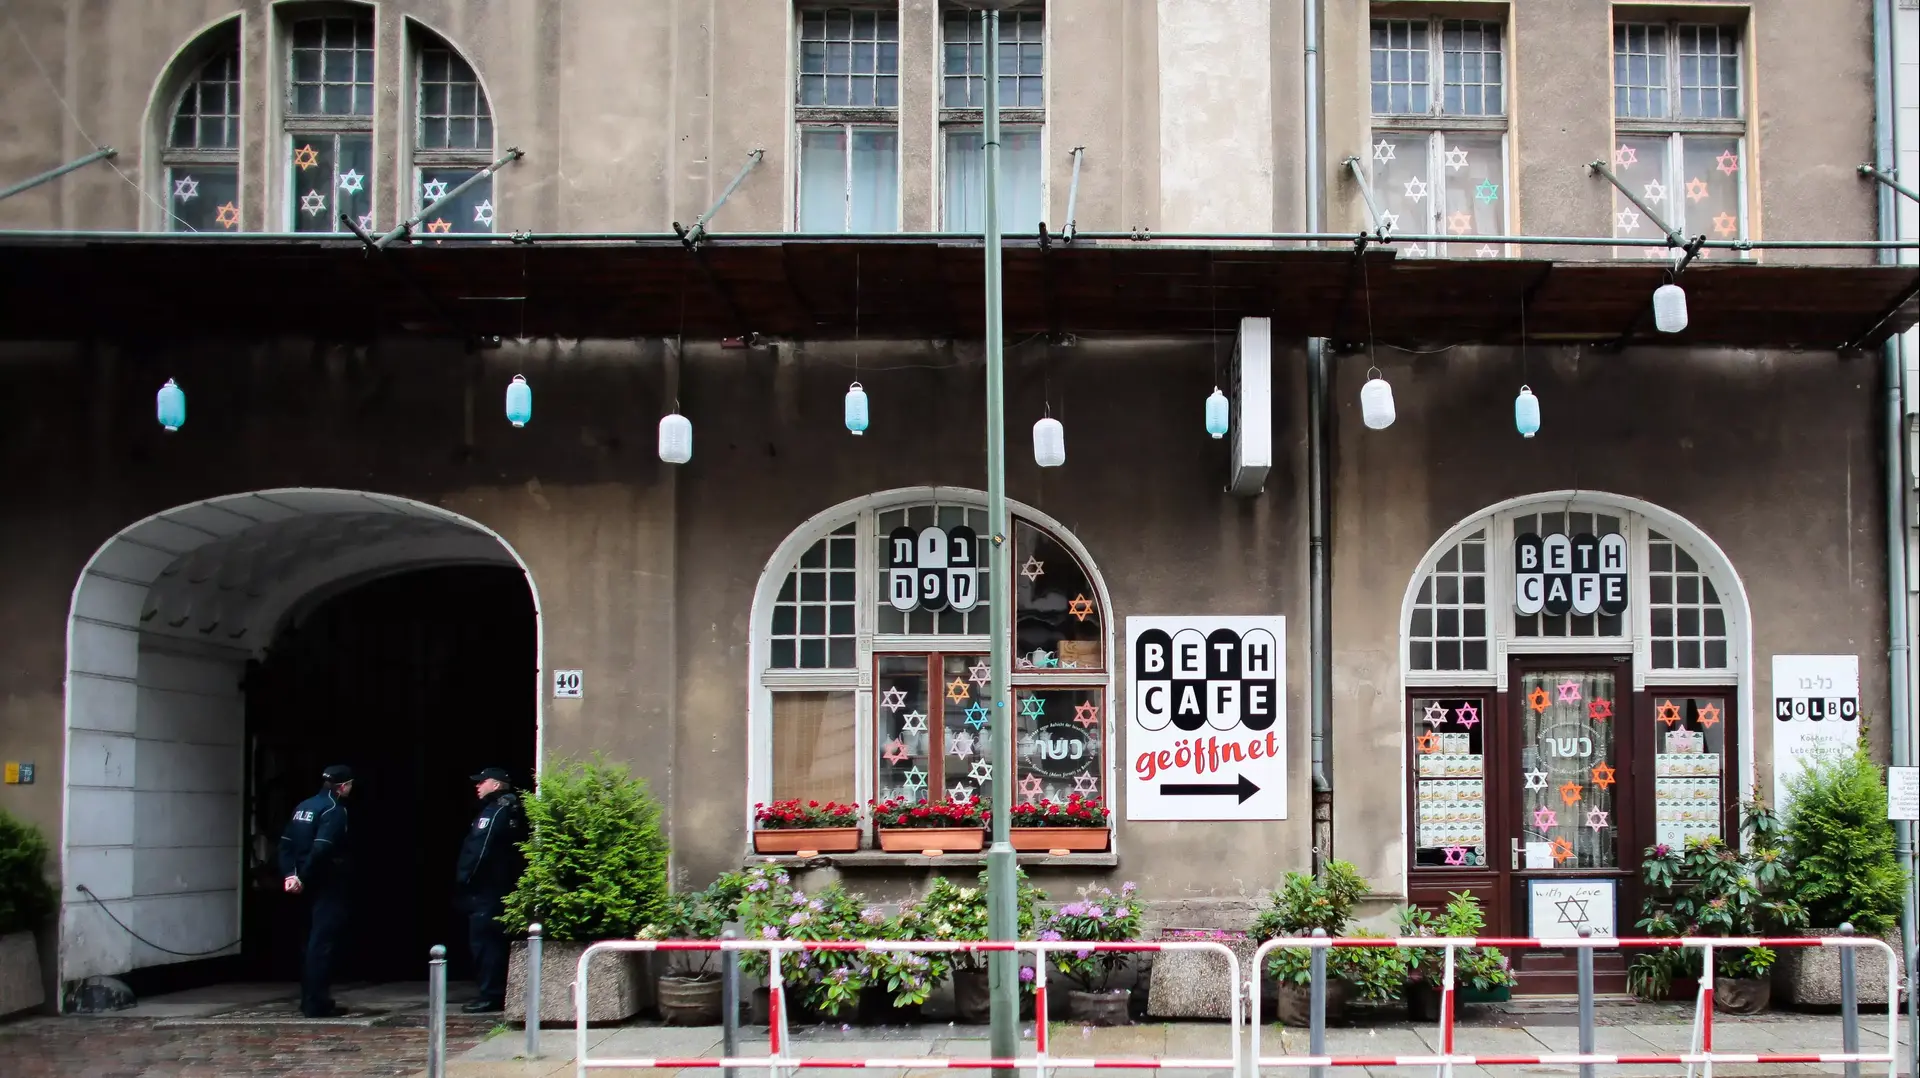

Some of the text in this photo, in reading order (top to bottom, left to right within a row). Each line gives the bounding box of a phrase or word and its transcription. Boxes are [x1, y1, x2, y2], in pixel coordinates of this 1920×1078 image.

[893, 537, 970, 563] בית
[1521, 544, 1621, 569] BETH
[895, 573, 971, 604] קפה
[1523, 577, 1622, 602] CAFE
[1144, 643, 1268, 673] BETH
[556, 673, 580, 689] 40
[1144, 685, 1268, 715] CAFE
[1778, 700, 1855, 717] KOLBO
[1036, 738, 1083, 760] כשר
[1135, 730, 1280, 782] geöffnet
[1545, 737, 1592, 757] כשר
[1575, 887, 1601, 896] Love
